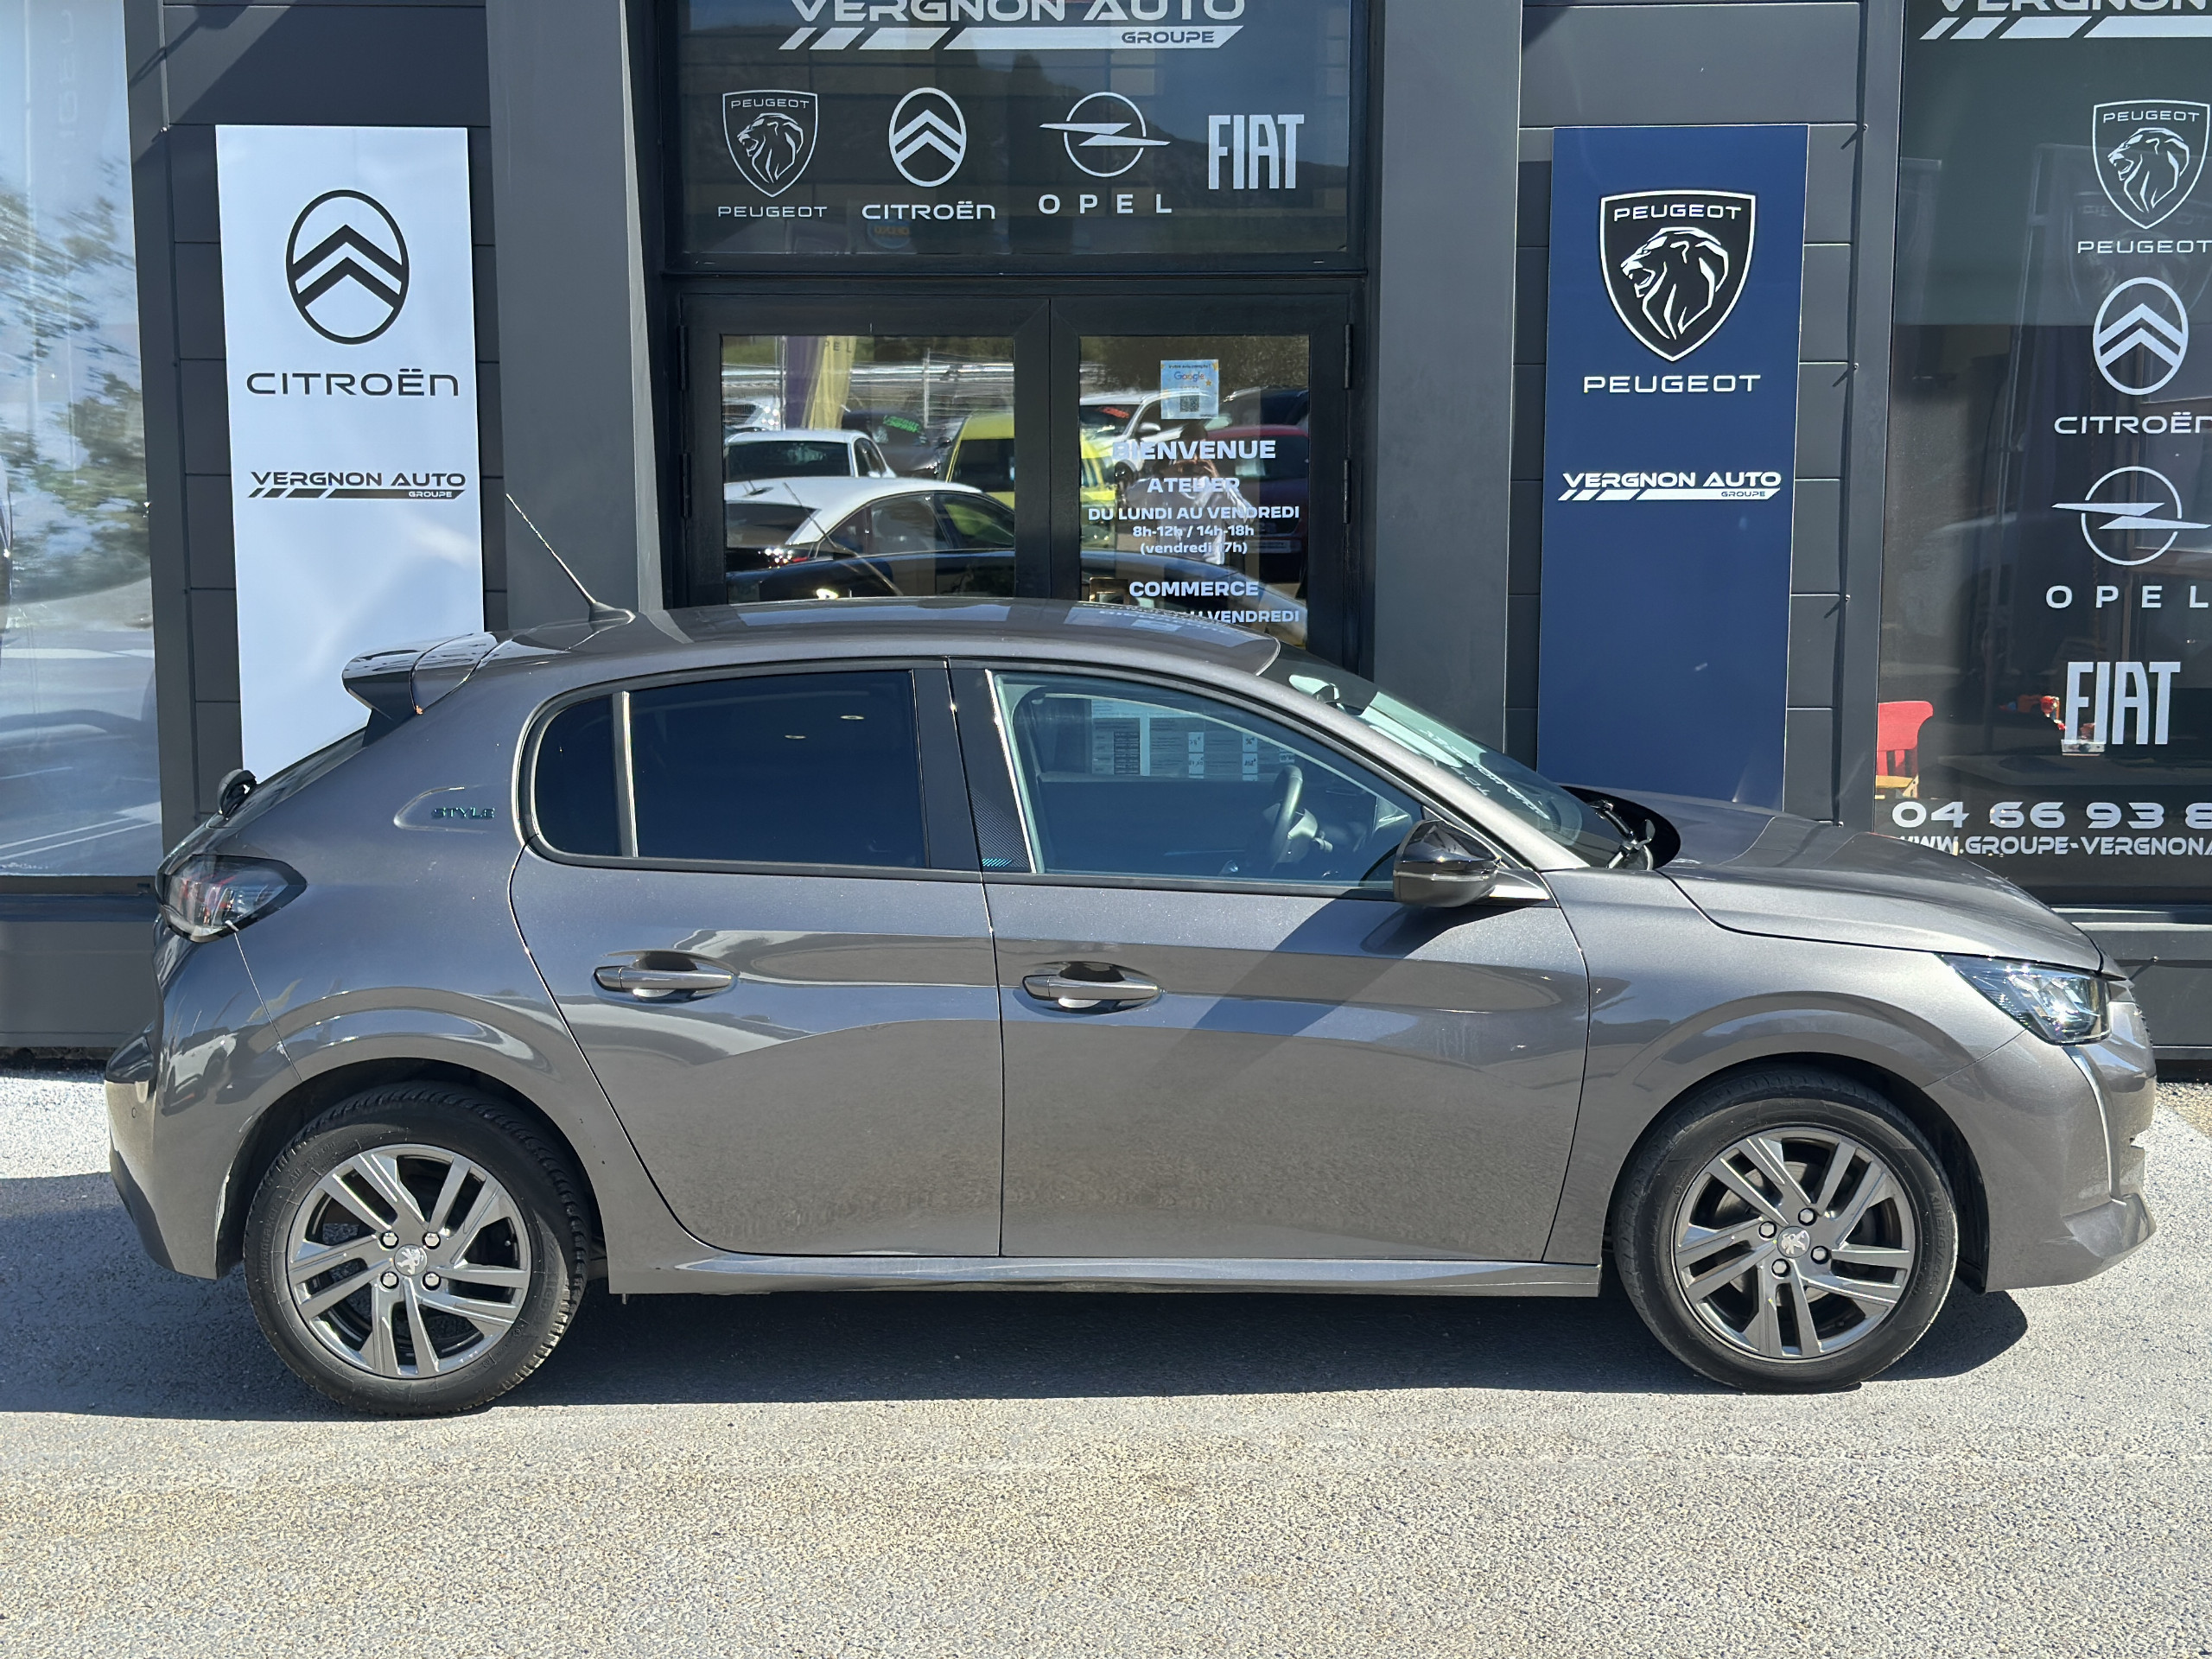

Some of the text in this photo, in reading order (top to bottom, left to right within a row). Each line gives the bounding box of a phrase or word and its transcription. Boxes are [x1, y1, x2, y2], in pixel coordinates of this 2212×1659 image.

[1121, 31, 1215, 44] GROUPE
[731, 99, 810, 110] PEUGEOT
[2103, 111, 2200, 123] PEUGEOT
[1209, 114, 1304, 189] FIAT
[1038, 194, 1173, 214] OPEL
[717, 206, 828, 219] PEUGEOT
[1614, 204, 1742, 221] PEUGEOT
[2077, 239, 2212, 253] PEUGEOT
[1173, 372, 1205, 382] Google
[1584, 375, 1761, 392] PEUGEOT
[1112, 441, 1276, 460] BIENVENUE
[251, 472, 466, 486] VERGNON AUTO
[1147, 478, 1240, 493] ATELIER
[1562, 472, 1782, 487] VERGNON AUTO
[1089, 505, 1300, 520] DU LUNDI AU VENDREDI
[1133, 525, 1183, 537] 8h-12h
[1197, 524, 1255, 537] 14h-18h
[1140, 543, 1212, 555] (vendredi
[1128, 581, 1259, 597] COMMERCE
[2045, 585, 2209, 609] OPEL
[2064, 662, 2181, 745] FIAT
[432, 807, 495, 819] STYLE
[1891, 801, 1970, 829] 04
[1989, 801, 2066, 829] 66
[2086, 802, 2164, 830] 93
